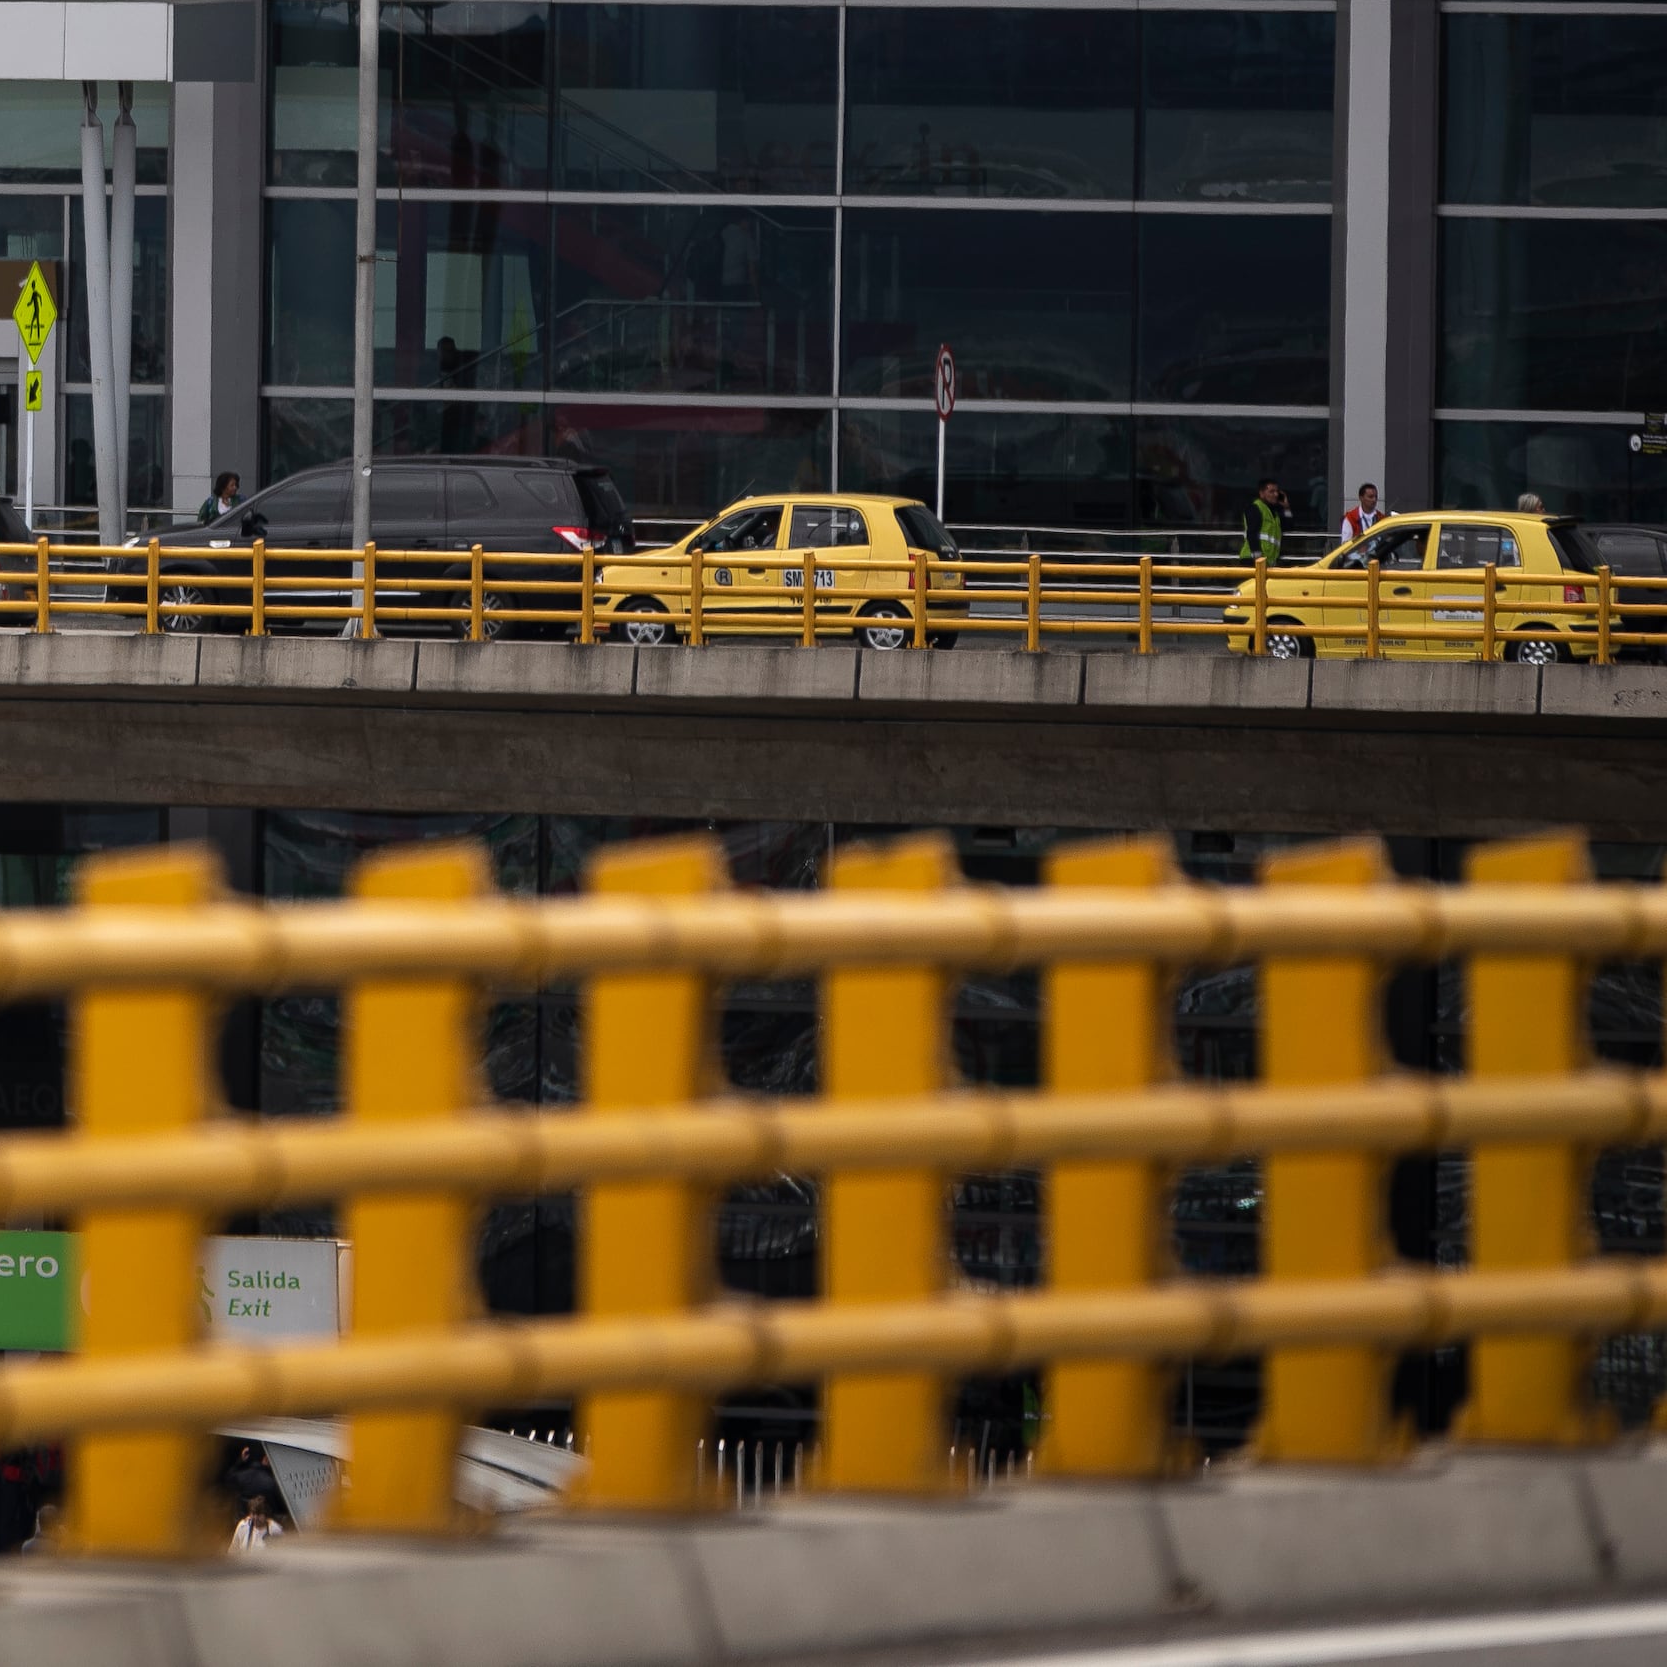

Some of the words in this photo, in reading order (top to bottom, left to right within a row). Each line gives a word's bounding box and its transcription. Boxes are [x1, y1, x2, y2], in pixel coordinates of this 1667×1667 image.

[785, 570, 804, 587] SM
[227, 1269, 301, 1291] Salida
[227, 1296, 272, 1319] Exit
